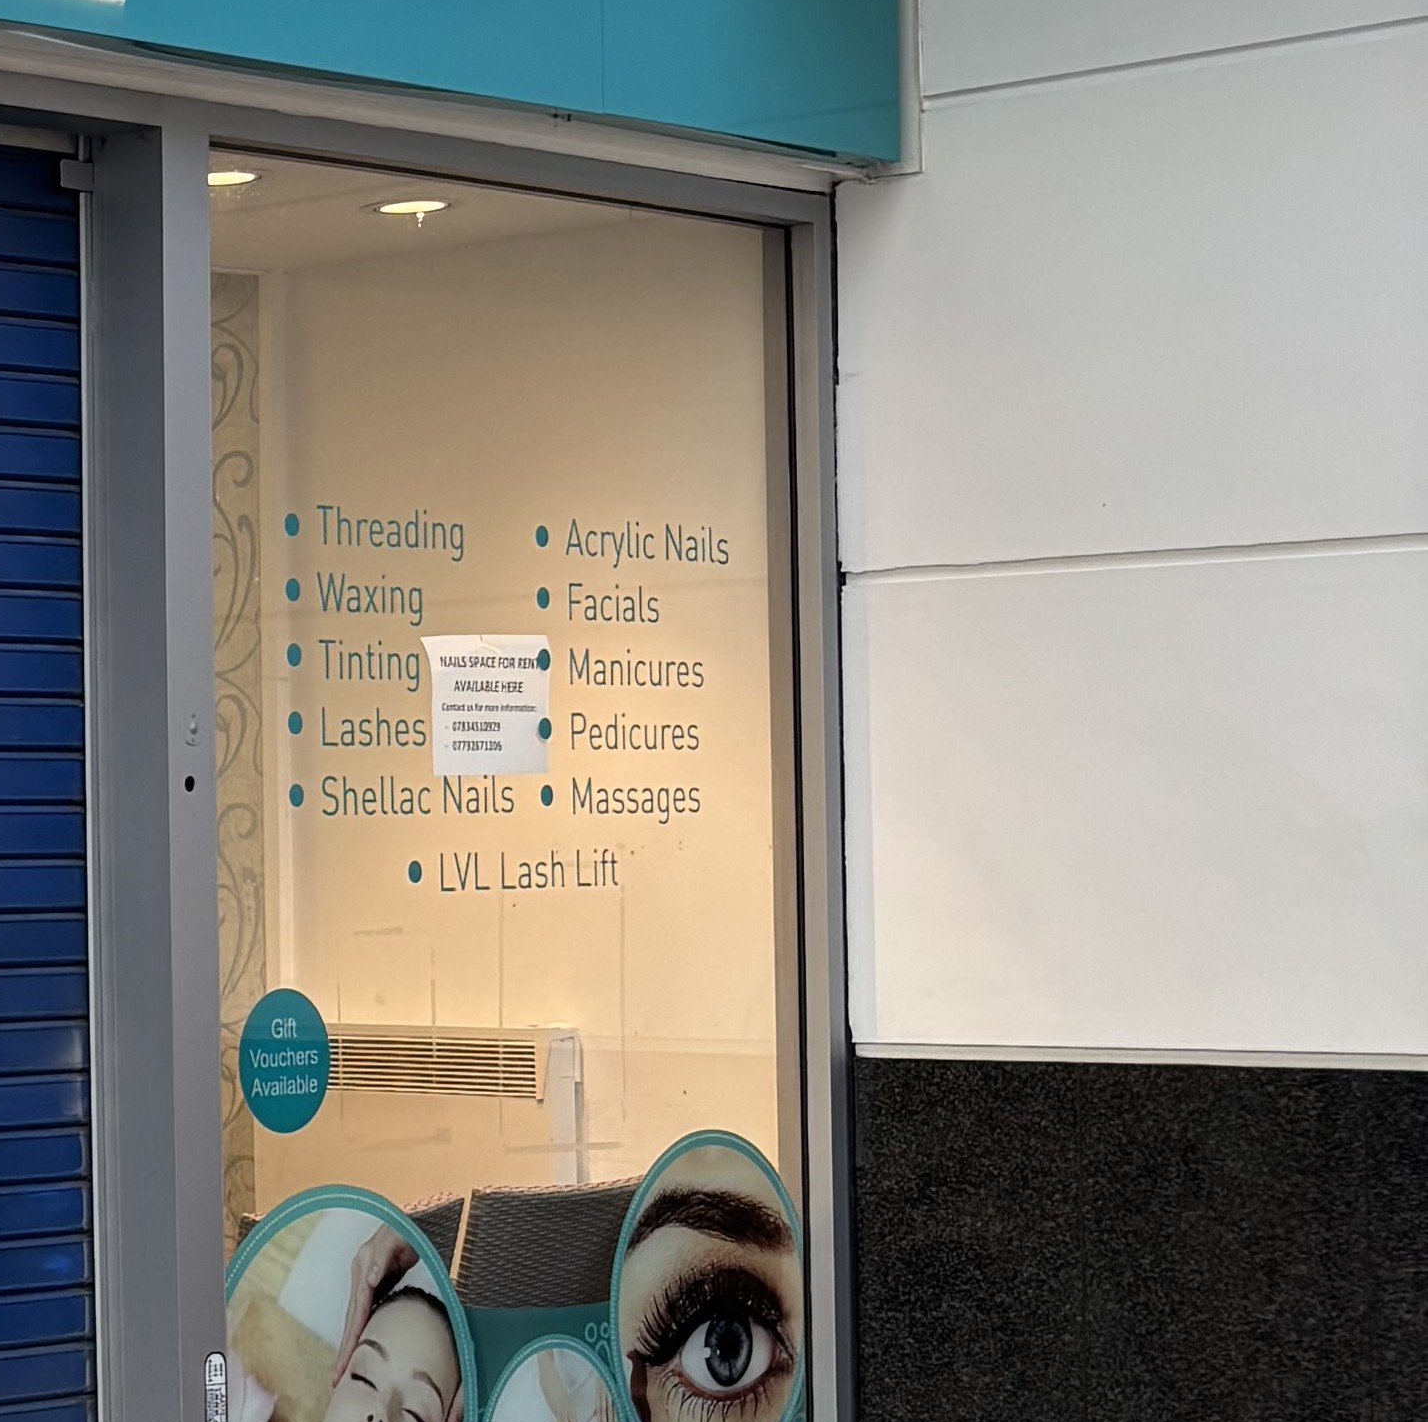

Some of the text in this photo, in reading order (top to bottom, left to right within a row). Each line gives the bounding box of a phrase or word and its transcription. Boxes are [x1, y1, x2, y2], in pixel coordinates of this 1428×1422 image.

[316, 505, 466, 561] Threading
[566, 518, 729, 567] Acrylic Nails
[316, 572, 424, 626] Waxing
[567, 583, 660, 624] Facials
[319, 639, 420, 692] Tinting
[440, 656, 466, 668] NAILS
[470, 657, 495, 668] SPACE
[498, 658, 515, 669] FOR
[568, 649, 704, 689] Manicures
[454, 681, 523, 693] AVAILABLE HERE
[321, 708, 427, 748] Lashes
[570, 713, 699, 752] Pedicures
[322, 776, 514, 816] Shellac Nails
[572, 778, 701, 824] Massages
[439, 850, 619, 893] LVL Lash Lift
[271, 1017, 297, 1039] Gift
[250, 1048, 318, 1068] Vouchers
[251, 1075, 318, 1098] Available
